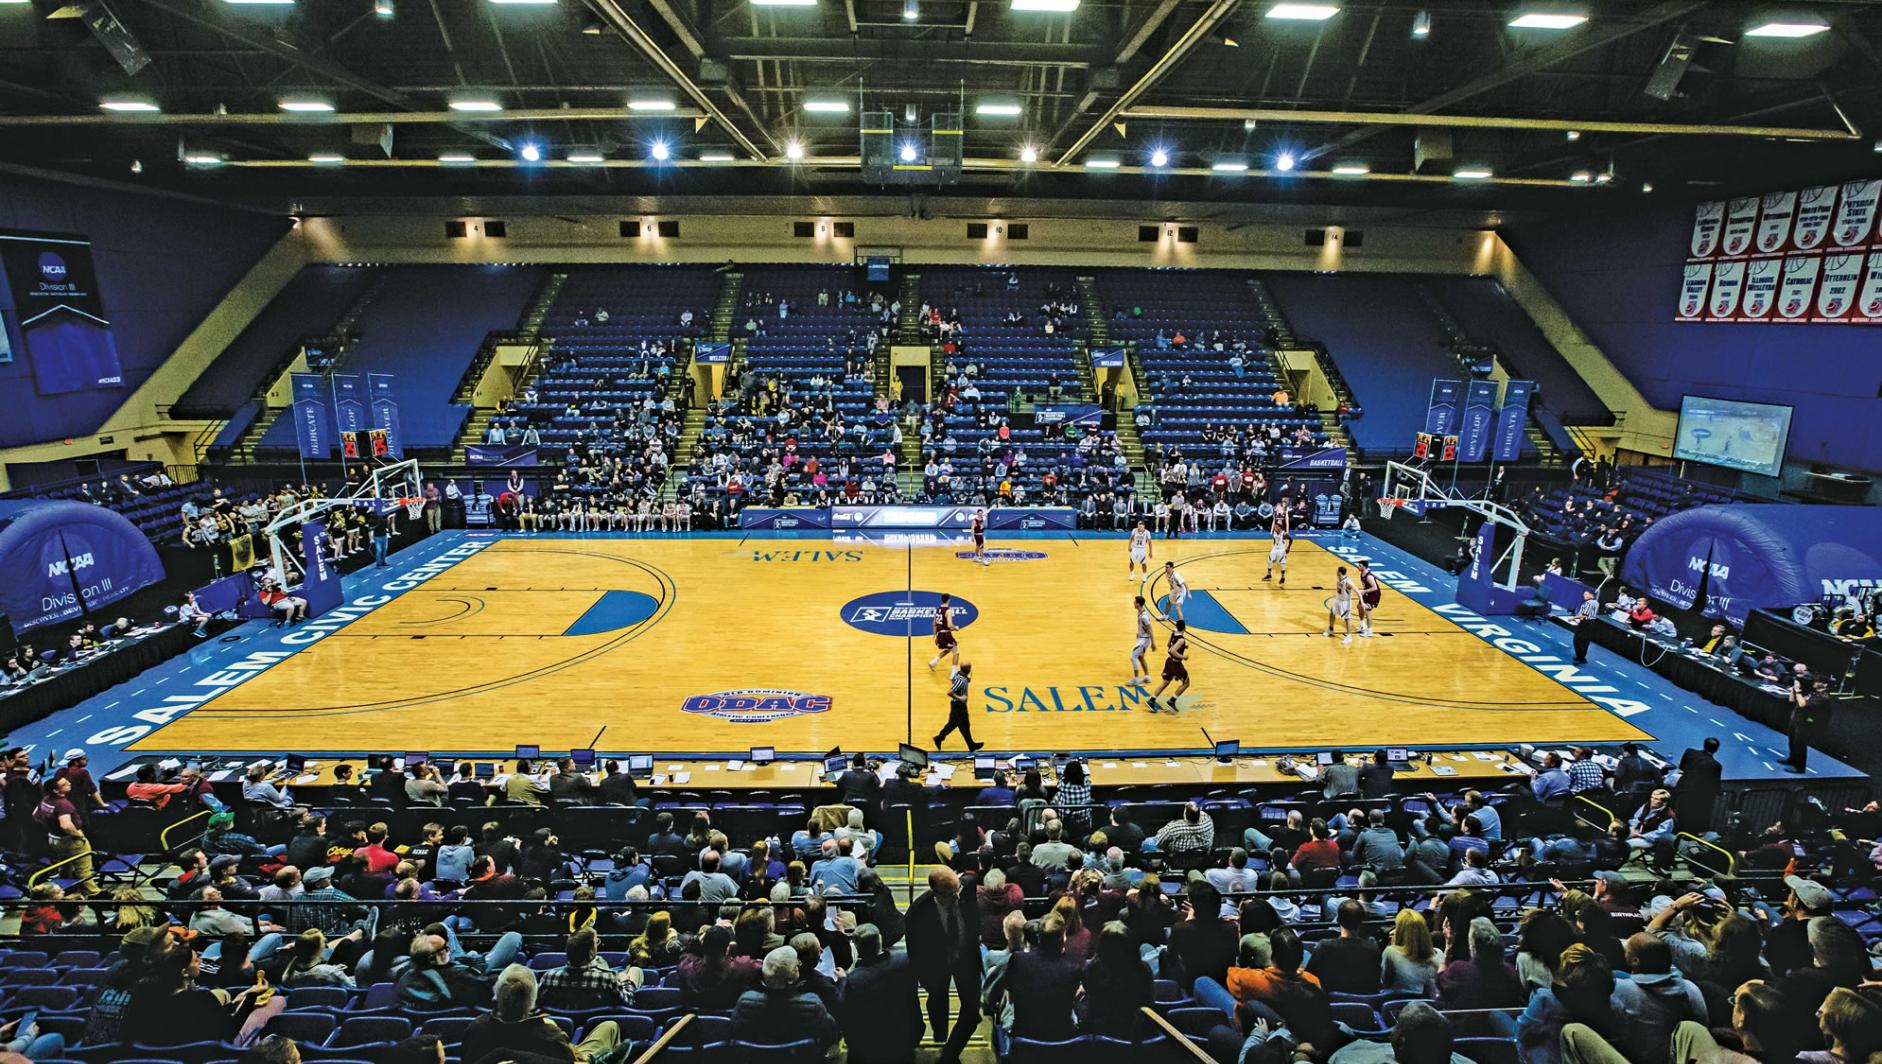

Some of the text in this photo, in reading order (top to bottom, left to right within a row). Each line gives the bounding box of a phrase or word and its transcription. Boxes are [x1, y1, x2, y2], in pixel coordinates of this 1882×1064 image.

[1167, 229, 1173, 237] 12
[42, 265, 66, 275] NCAA
[1823, 273, 1858, 282] OTTERBEIN
[40, 282, 67, 291] Division
[306, 407, 319, 455] DEDICATE
[1469, 414, 1482, 457] DEVELOP
[1503, 411, 1518, 457] DEDICATE
[1310, 459, 1343, 467] BASKETBALL
[313, 535, 328, 582] SALEM
[753, 550, 864, 562] SALEM
[1470, 535, 1484, 580] SALEM
[42, 584, 101, 612] Divison
[101, 577, 112, 591] III
[86, 540, 494, 746] SALEM CIVIC CENTER
[1432, 603, 1653, 718] VIRGINIA
[681, 695, 833, 713] ODAC
[984, 685, 1169, 713] SALEM
